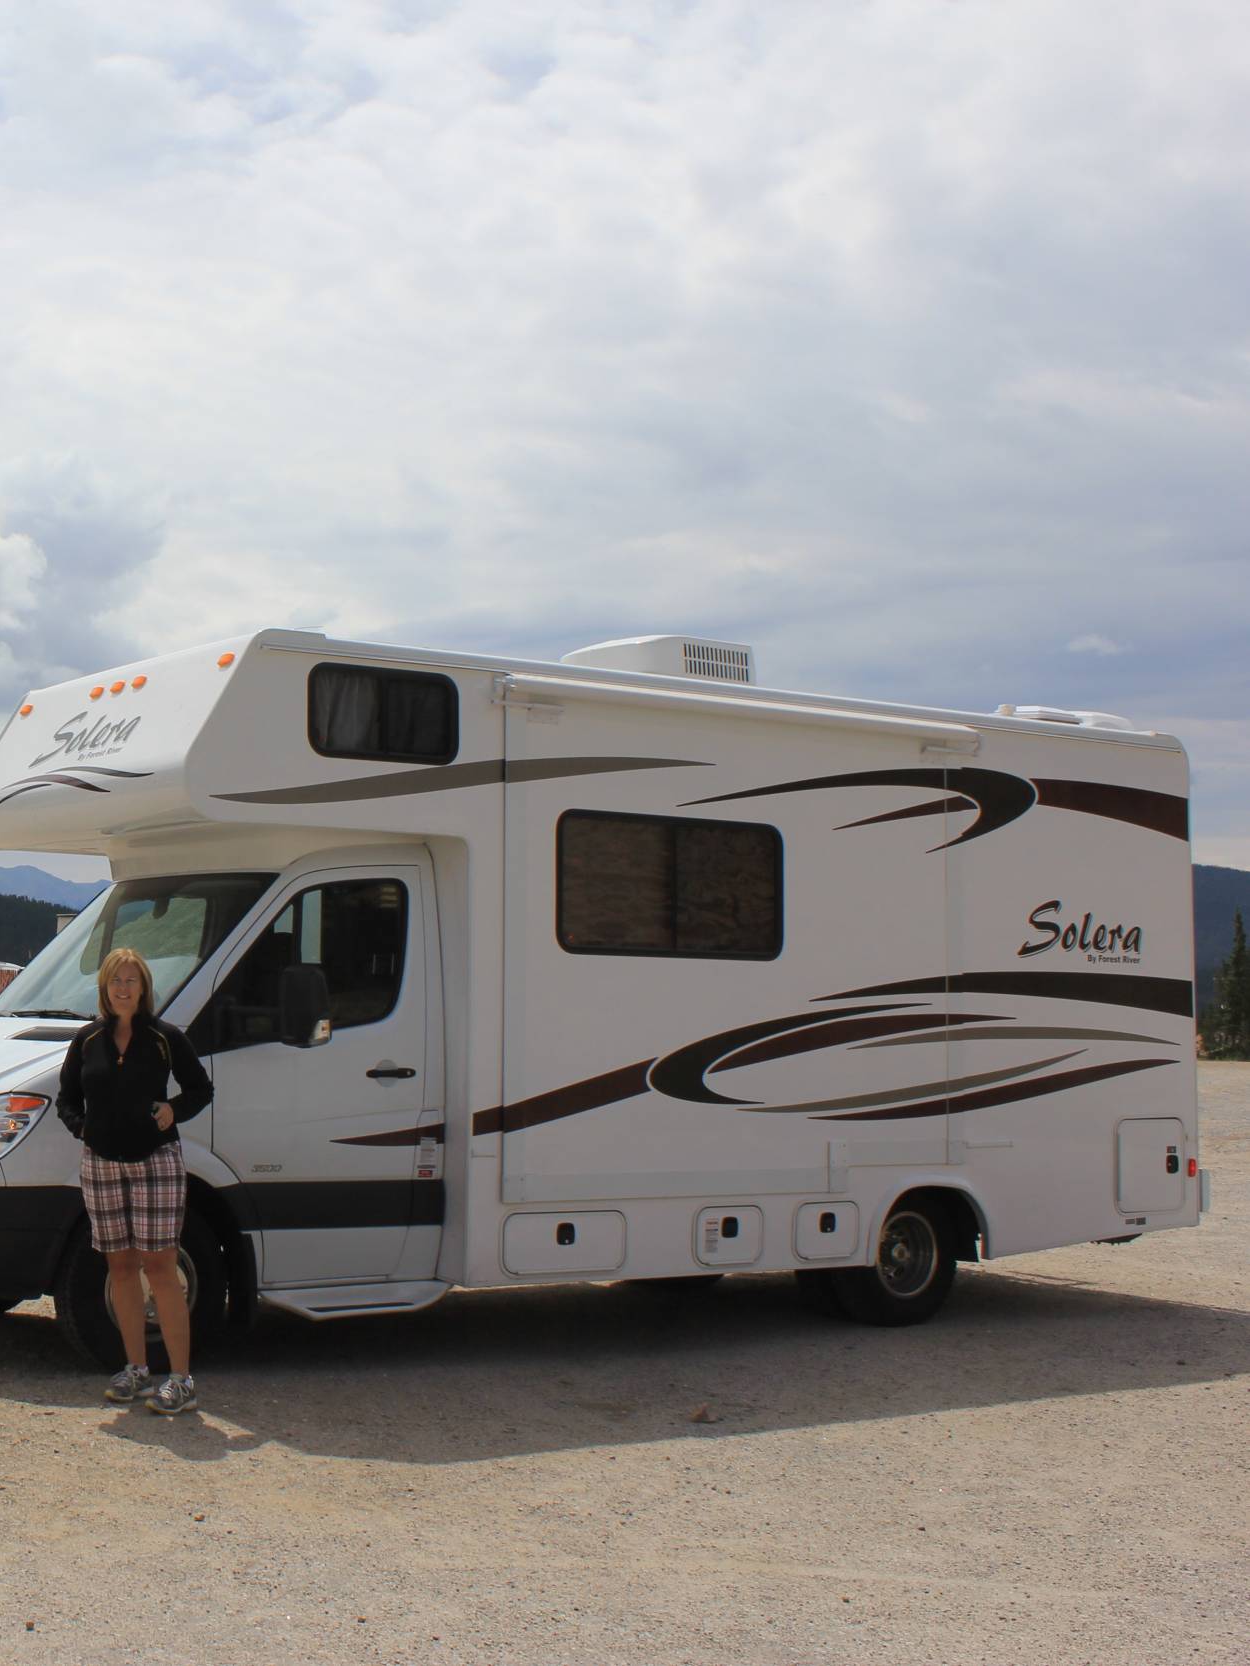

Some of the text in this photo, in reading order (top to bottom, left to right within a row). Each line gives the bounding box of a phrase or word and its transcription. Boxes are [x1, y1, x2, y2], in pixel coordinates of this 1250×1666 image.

[28, 711, 141, 768] Solera
[1017, 900, 1141, 958] Solera
[1087, 954, 1141, 964] By Forest River
